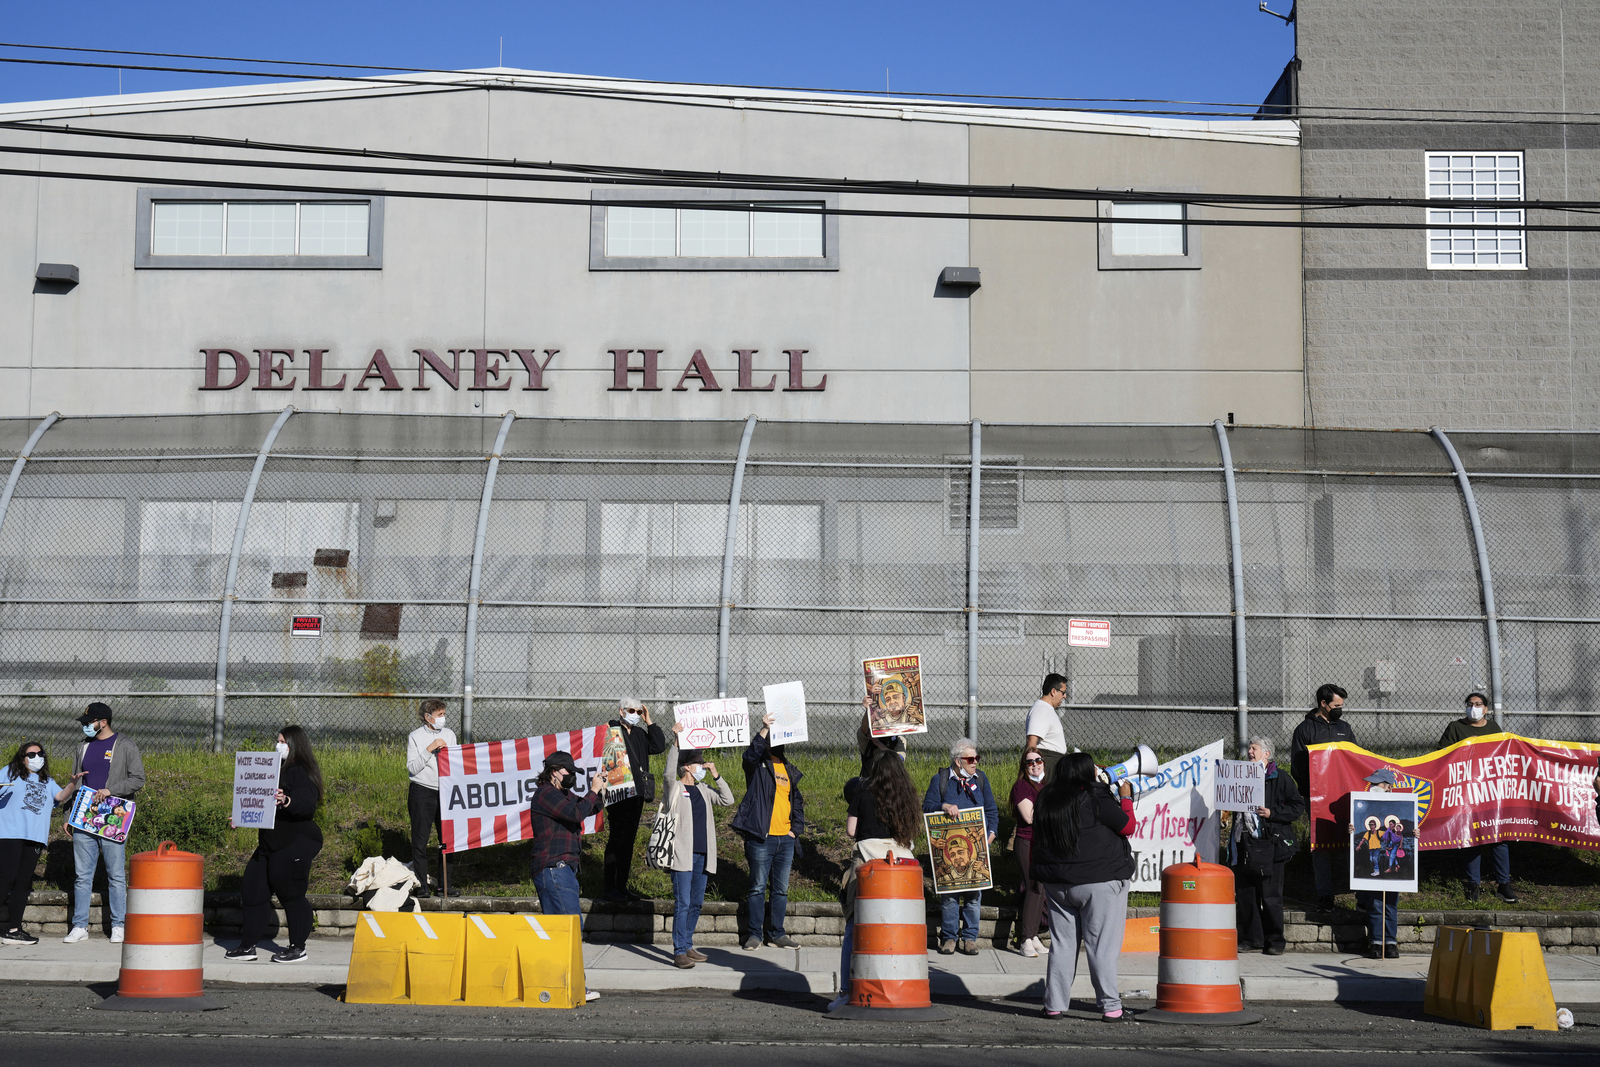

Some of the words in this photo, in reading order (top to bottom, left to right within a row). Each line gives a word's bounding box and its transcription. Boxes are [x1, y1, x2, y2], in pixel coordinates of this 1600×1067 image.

[198, 348, 560, 392] DELANEY
[606, 348, 828, 392] HALL
[865, 660, 886, 671] FREE
[887, 657, 917, 669] KILMAR
[677, 701, 713, 715] WHERE
[722, 699, 738, 712] IS
[679, 716, 699, 729] OUR
[702, 713, 749, 728] HUMANITY?
[690, 733, 713, 744] STOP
[237, 756, 252, 766] WHITE
[254, 757, 273, 766] SILENCE
[1217, 763, 1230, 778] NO
[1233, 764, 1243, 778] ICE
[1448, 758, 1472, 785] NEW
[1477, 754, 1532, 780] JERSEY
[448, 778, 538, 811] ABOLIS
[1216, 784, 1227, 803] NO
[1441, 783, 1464, 809] FOR
[1467, 777, 1553, 805] IMMIGRANT
[71, 789, 86, 823] IMMIGRANT
[75, 790, 93, 826] POWER
[240, 797, 264, 809] VIOLENCE
[241, 811, 264, 823] RESIST!
[958, 811, 981, 822] LIBRE
[1149, 802, 1206, 847] Misery
